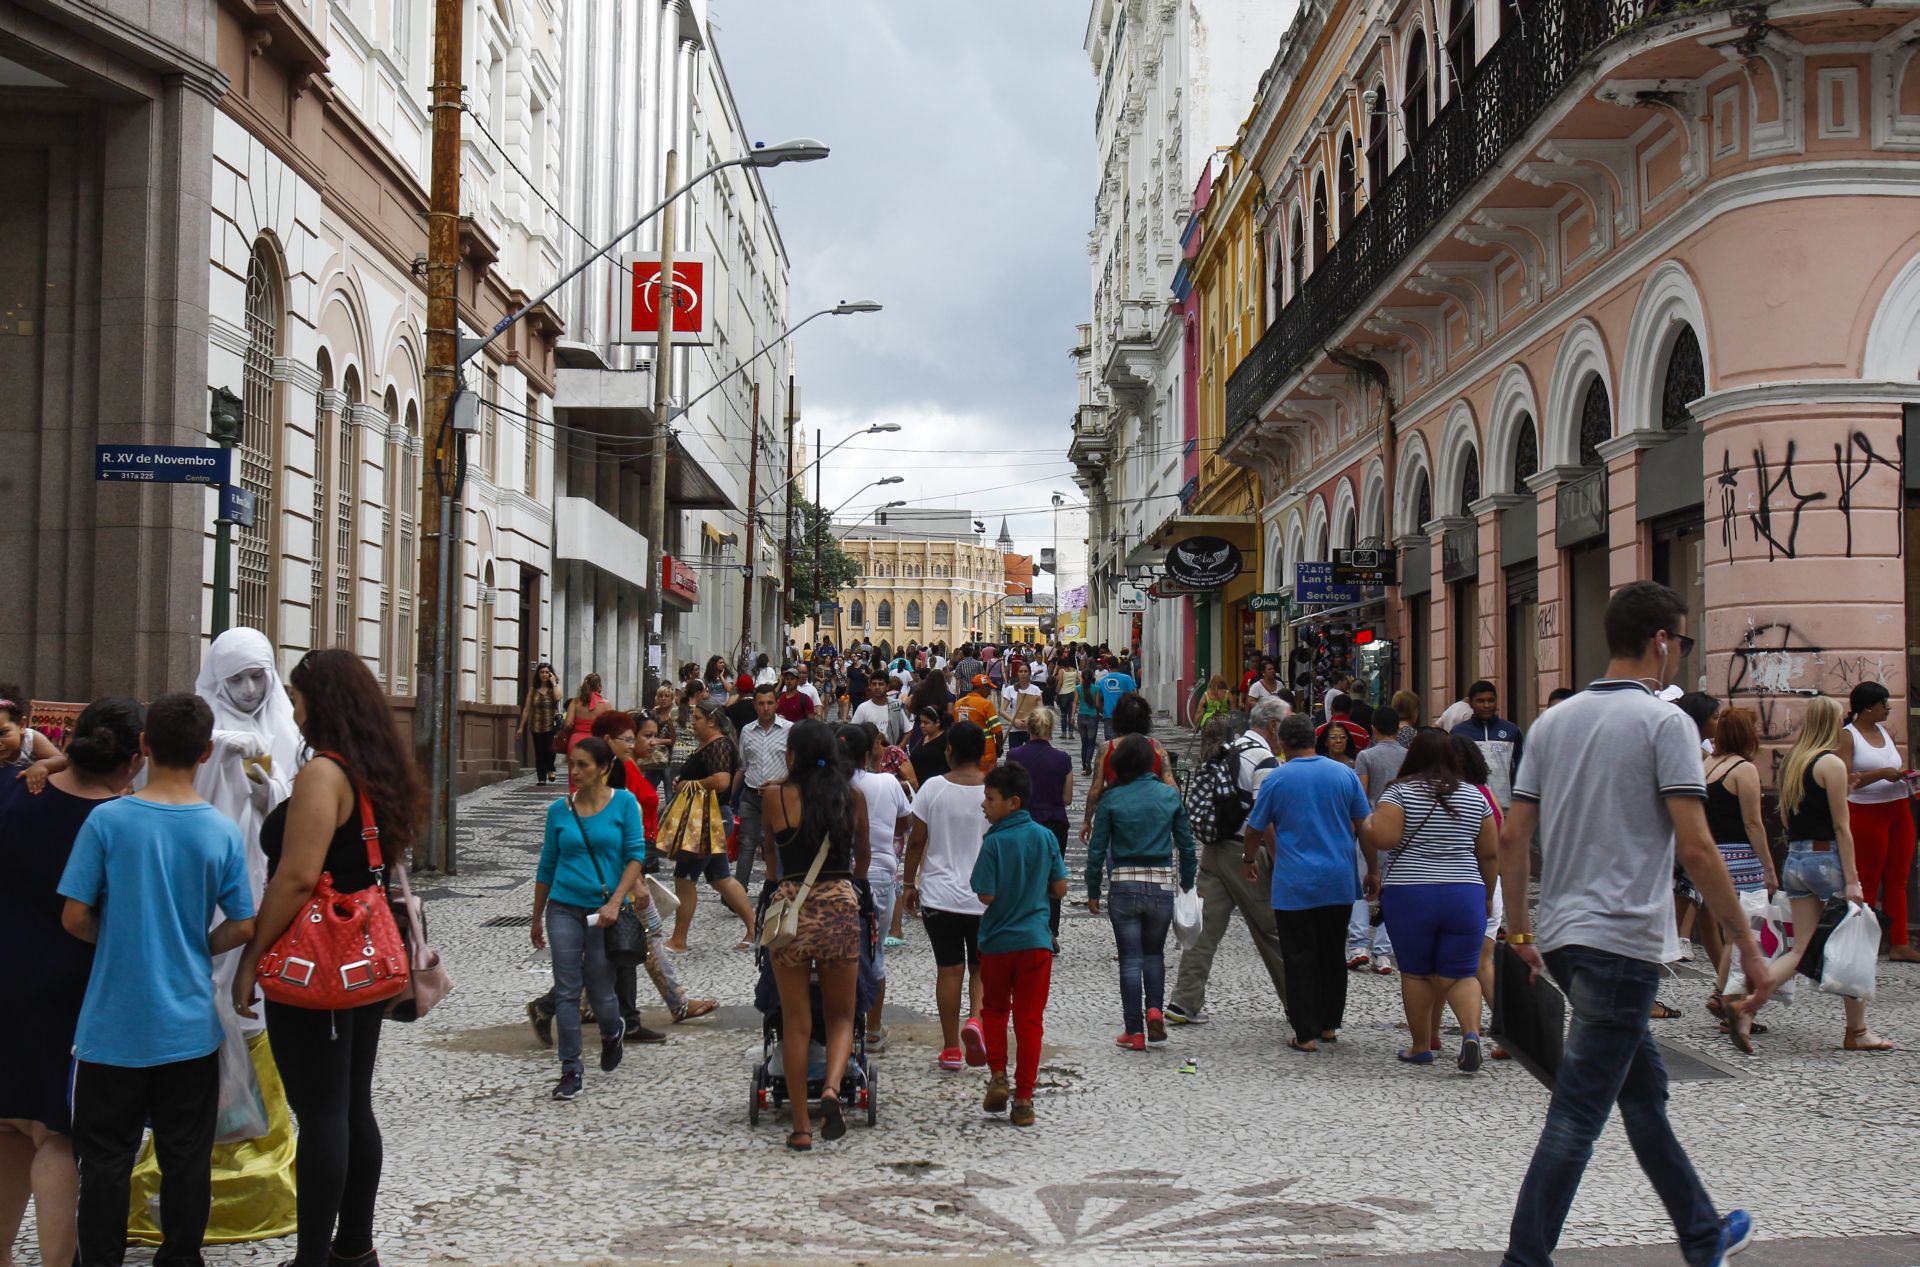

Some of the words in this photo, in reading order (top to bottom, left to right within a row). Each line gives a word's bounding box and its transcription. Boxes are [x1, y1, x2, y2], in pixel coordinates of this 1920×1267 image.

[102, 453, 114, 463] R.
[117, 453, 133, 463] XV
[136, 453, 151, 464] de
[154, 454, 216, 466] Novembro
[185, 474, 211, 482] Centro
[1302, 575, 1321, 583] Lan
[1326, 584, 1333, 592] e
[1306, 591, 1352, 602] Serviços
